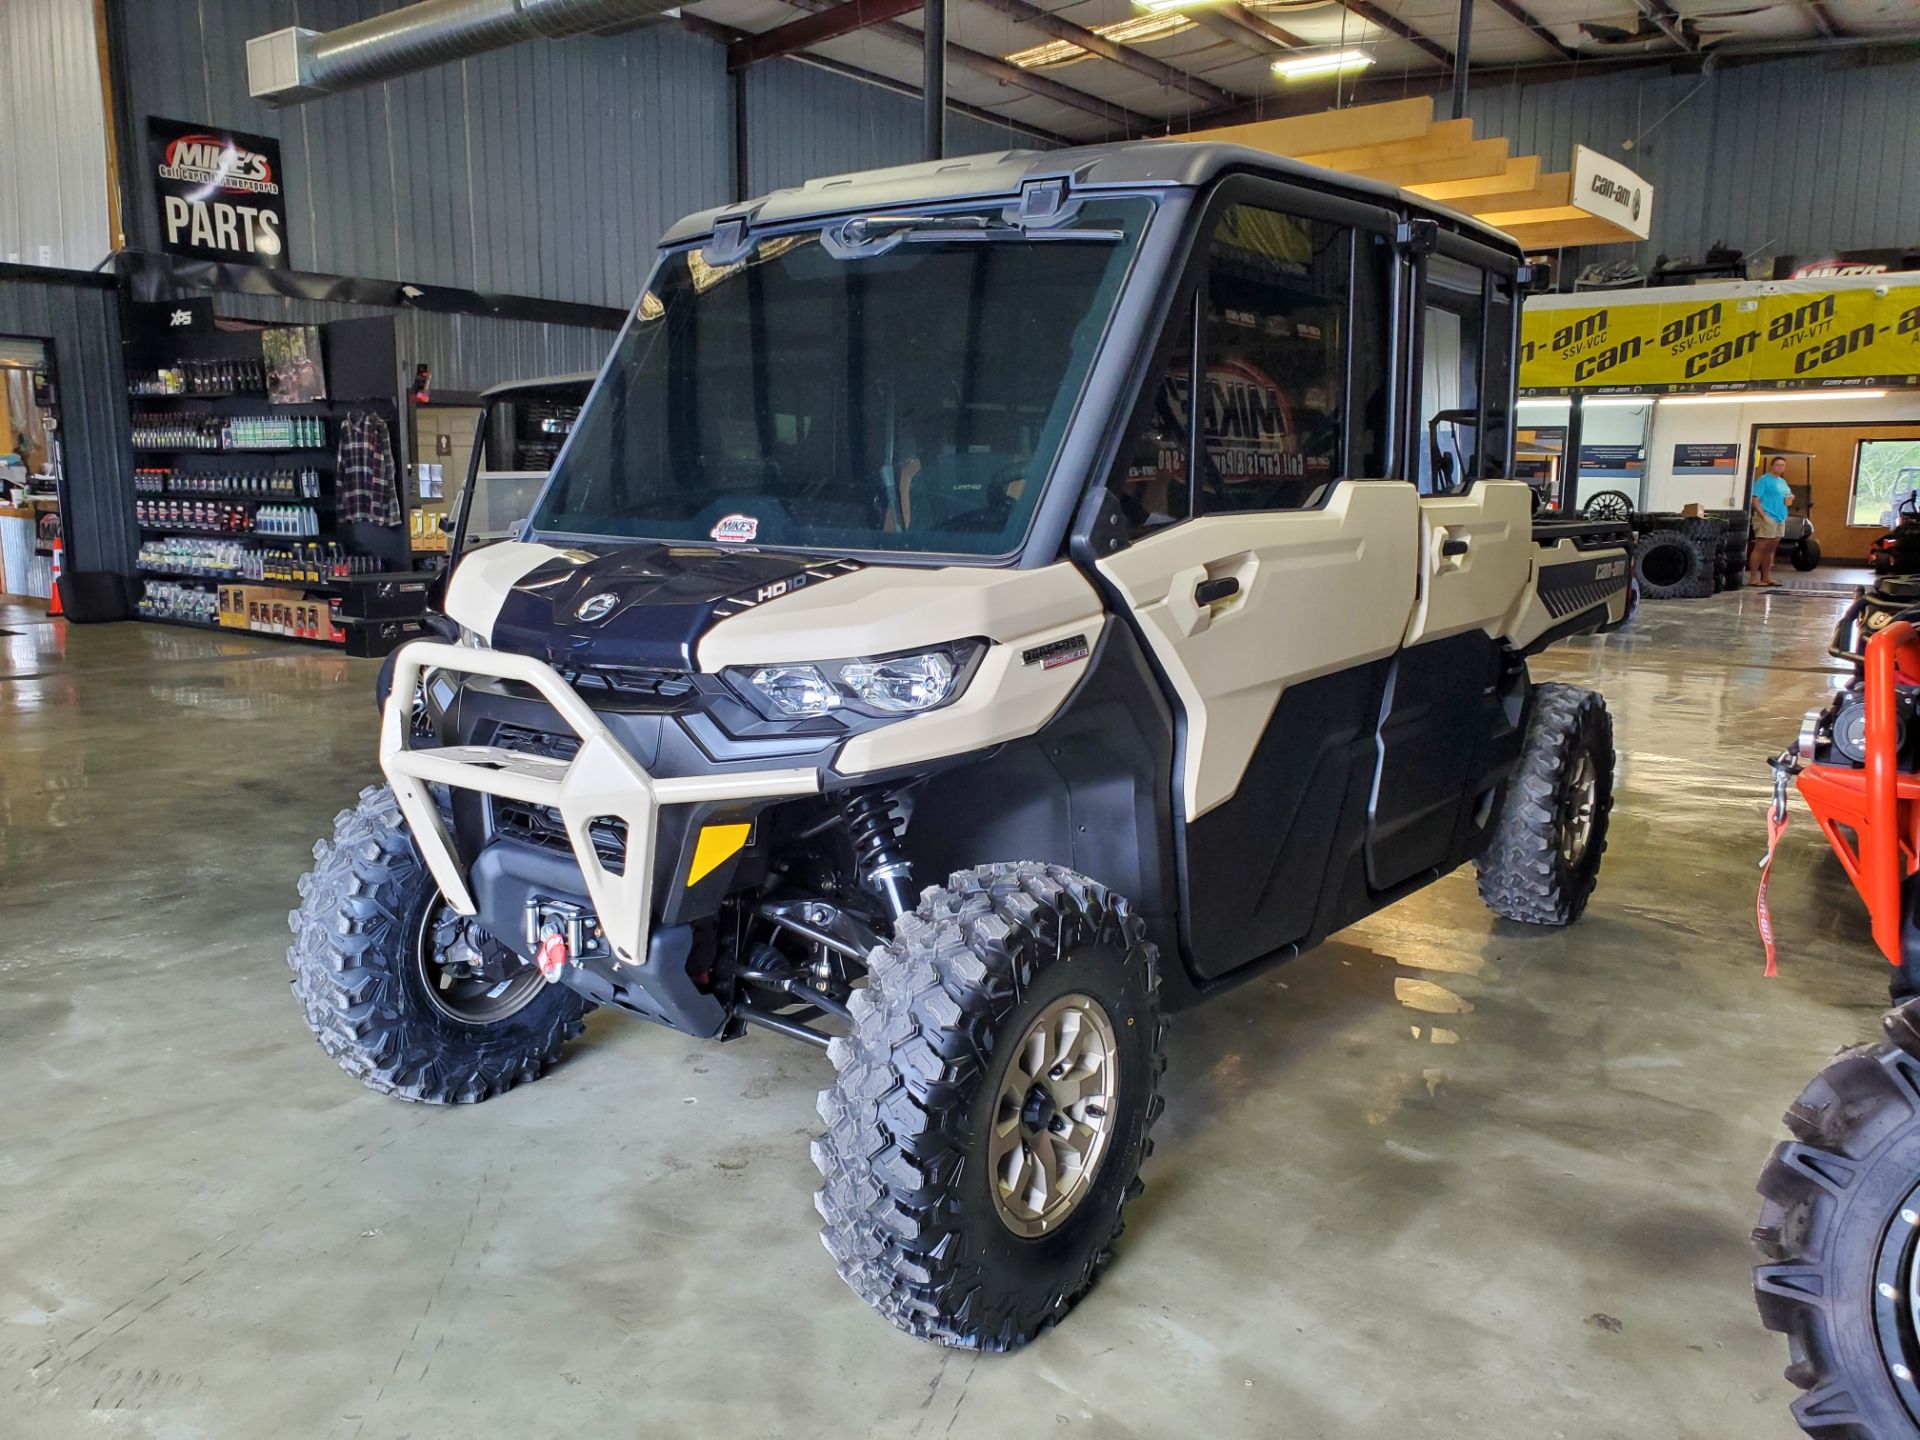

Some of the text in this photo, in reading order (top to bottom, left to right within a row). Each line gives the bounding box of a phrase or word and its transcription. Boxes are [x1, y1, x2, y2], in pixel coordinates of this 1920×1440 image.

[171, 141, 267, 180] MIKE'S
[181, 169, 209, 183] Carts
[1591, 174, 1631, 207] can-am
[165, 195, 281, 255] PARTS
[170, 309, 192, 326] XPS
[1562, 331, 1607, 361] SSV-VCC
[1671, 325, 1721, 356] SSV-VCC
[1781, 319, 1833, 350] ATV-VTT
[720, 519, 755, 531] MIKE'S
[758, 573, 806, 602] HD10
